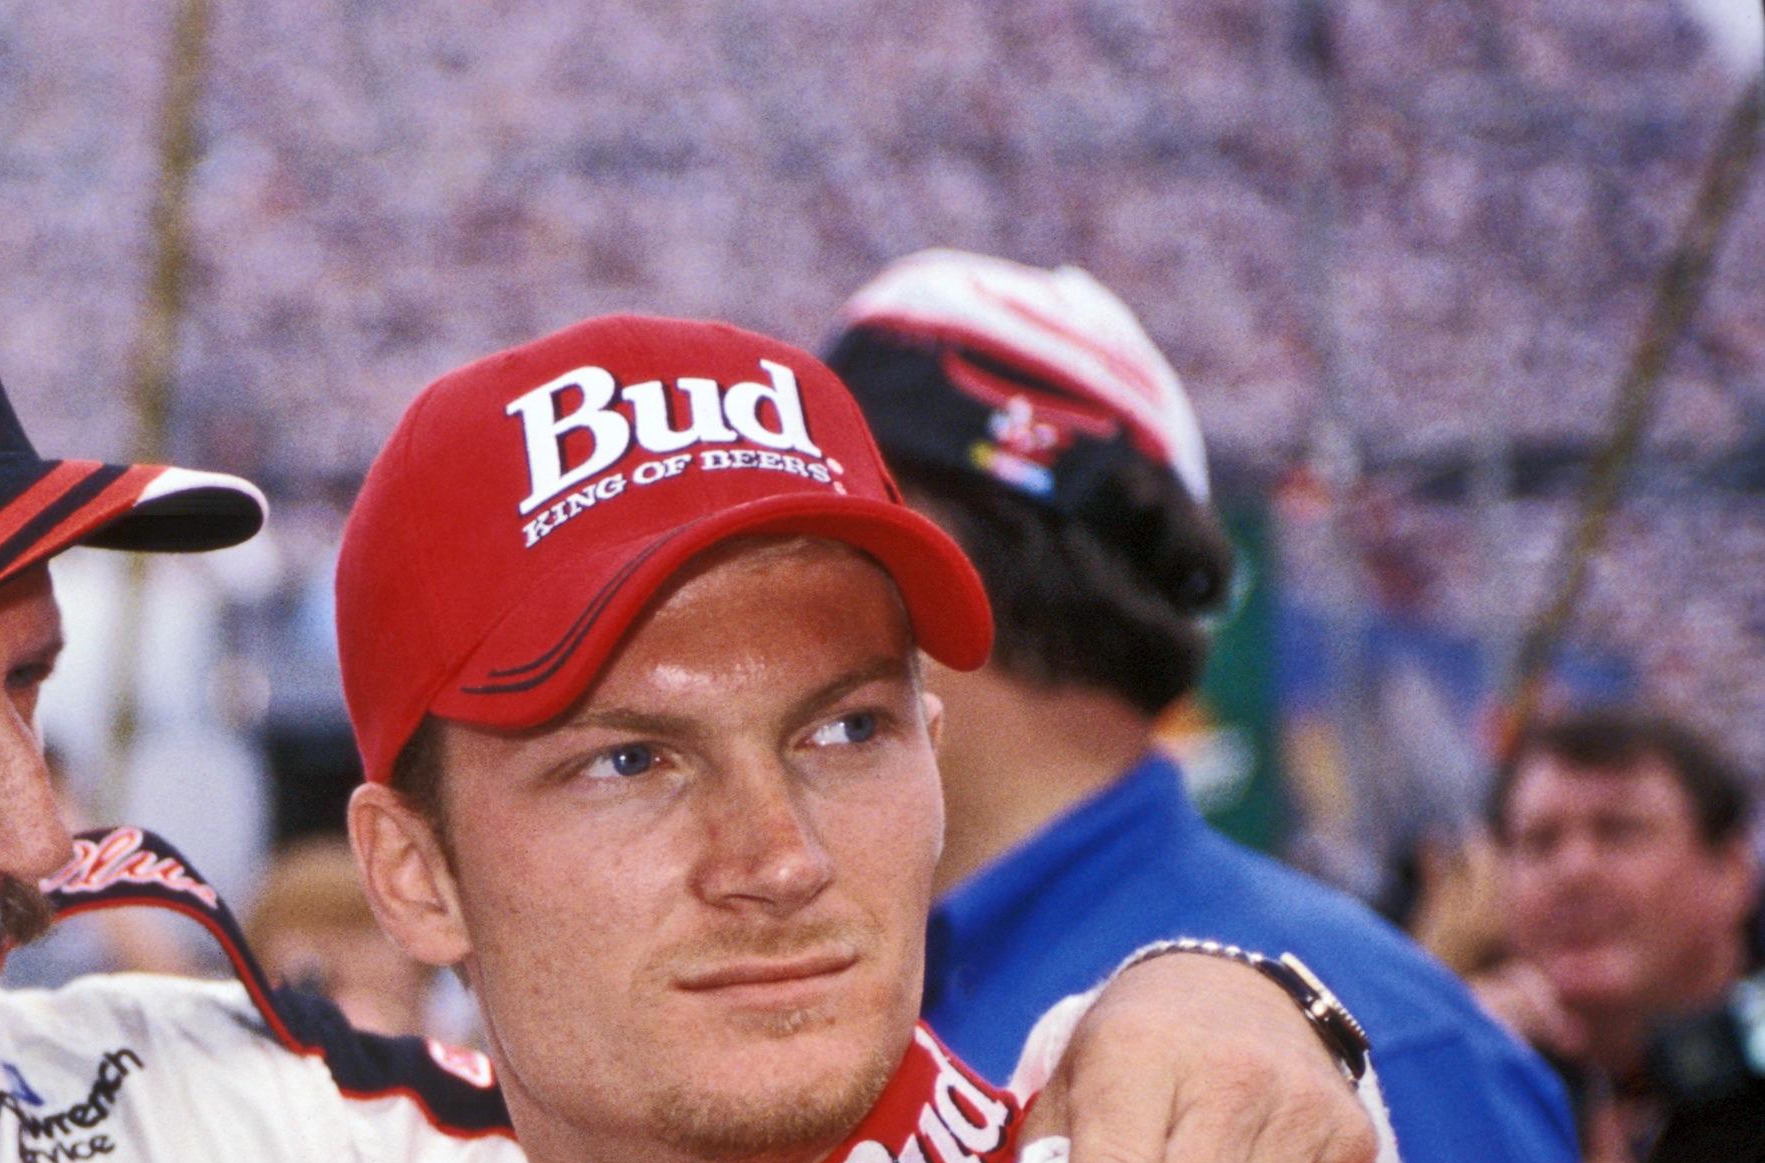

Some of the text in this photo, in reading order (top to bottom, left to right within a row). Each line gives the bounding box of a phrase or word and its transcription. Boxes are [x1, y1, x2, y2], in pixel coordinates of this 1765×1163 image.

[506, 358, 822, 515] Bud
[522, 449, 833, 548] KING OF BEERS
